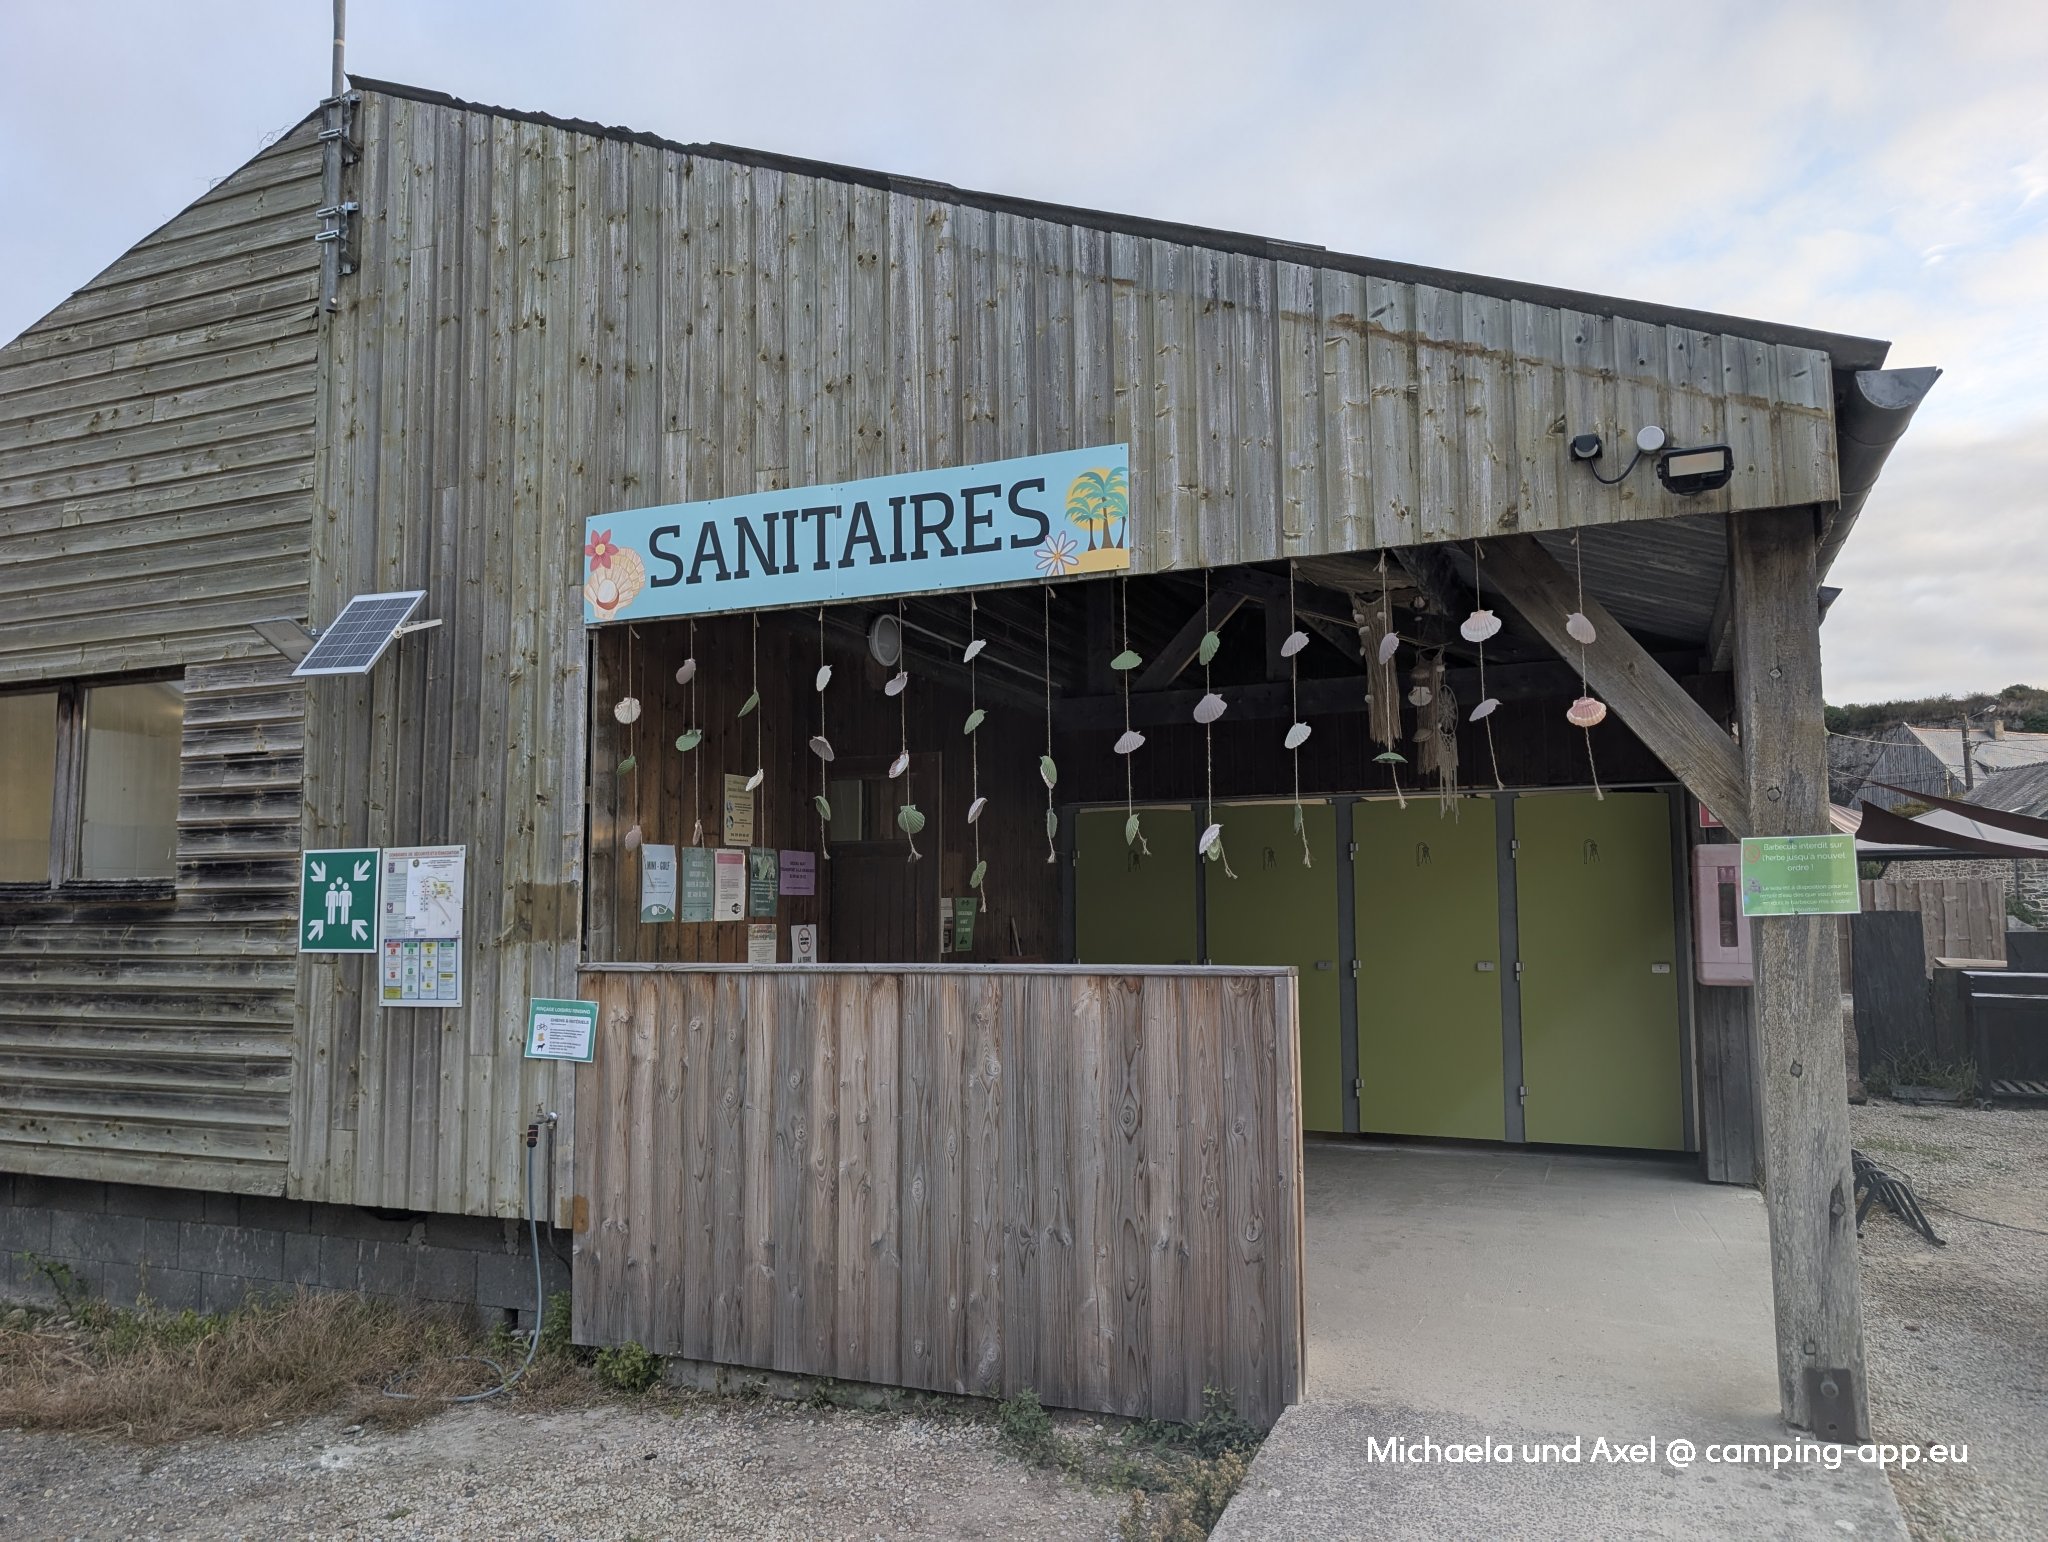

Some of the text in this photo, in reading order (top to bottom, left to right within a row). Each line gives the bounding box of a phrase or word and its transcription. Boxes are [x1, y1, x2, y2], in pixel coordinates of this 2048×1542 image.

[649, 477, 1050, 588] SANITAIRES
[1763, 843, 1797, 851] Barbecue
[1762, 854, 1785, 862] l'herbe
[1817, 852, 1846, 860] nouvel
